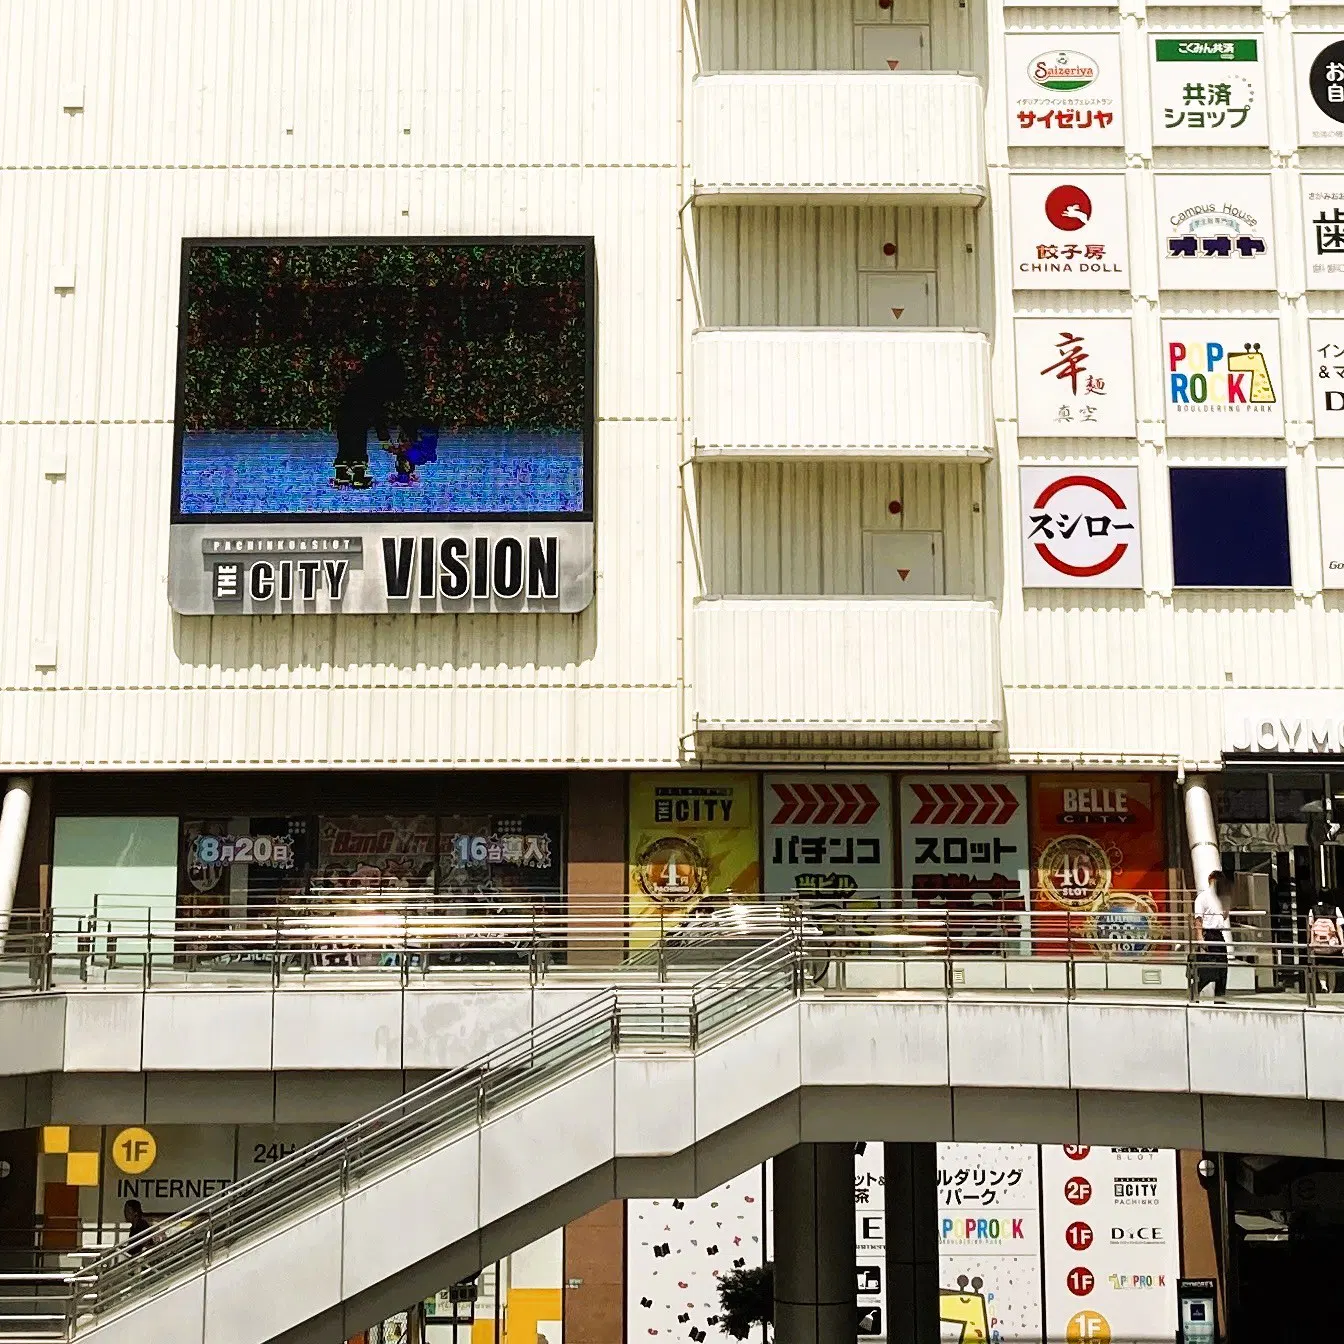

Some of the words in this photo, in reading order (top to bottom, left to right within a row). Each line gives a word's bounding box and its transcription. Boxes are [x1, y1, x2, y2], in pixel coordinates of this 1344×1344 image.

[1178, 41, 1235, 55] こくみん共済
[1034, 61, 1094, 79] Saizeriya
[1182, 82, 1232, 106] 共済
[1017, 108, 1114, 129] サイゼリヤ
[1164, 104, 1251, 129] ショップ
[1170, 203, 1216, 226] Campus
[1223, 202, 1258, 227] House
[1036, 244, 1106, 261] 餃子房
[1020, 263, 1073, 273] CHINA
[1080, 263, 1122, 273] DOLL
[1169, 342, 1224, 372] POP
[1171, 373, 1248, 404] ROCK
[1027, 512, 1135, 540] スシロー
[216, 563, 238, 598] THE
[249, 559, 350, 601] CITY
[381, 535, 560, 600] VISION
[658, 801, 670, 820] THE
[676, 799, 733, 822] CITY
[1063, 788, 1129, 813] BELLE
[1064, 815, 1128, 823] CITY
[199, 835, 289, 862] 8月20日
[772, 836, 881, 864] パチンコ
[914, 837, 1018, 864] スロット
[1062, 887, 1088, 896] SLOT
[121, 1139, 149, 1162] 1F
[945, 1188, 997, 1206] パーク
[1068, 1181, 1090, 1200] 2F
[1126, 1184, 1157, 1197] CITY
[1069, 1226, 1092, 1245] 1F
[1070, 1272, 1093, 1291] 1F
[1075, 1315, 1102, 1338] 1F
